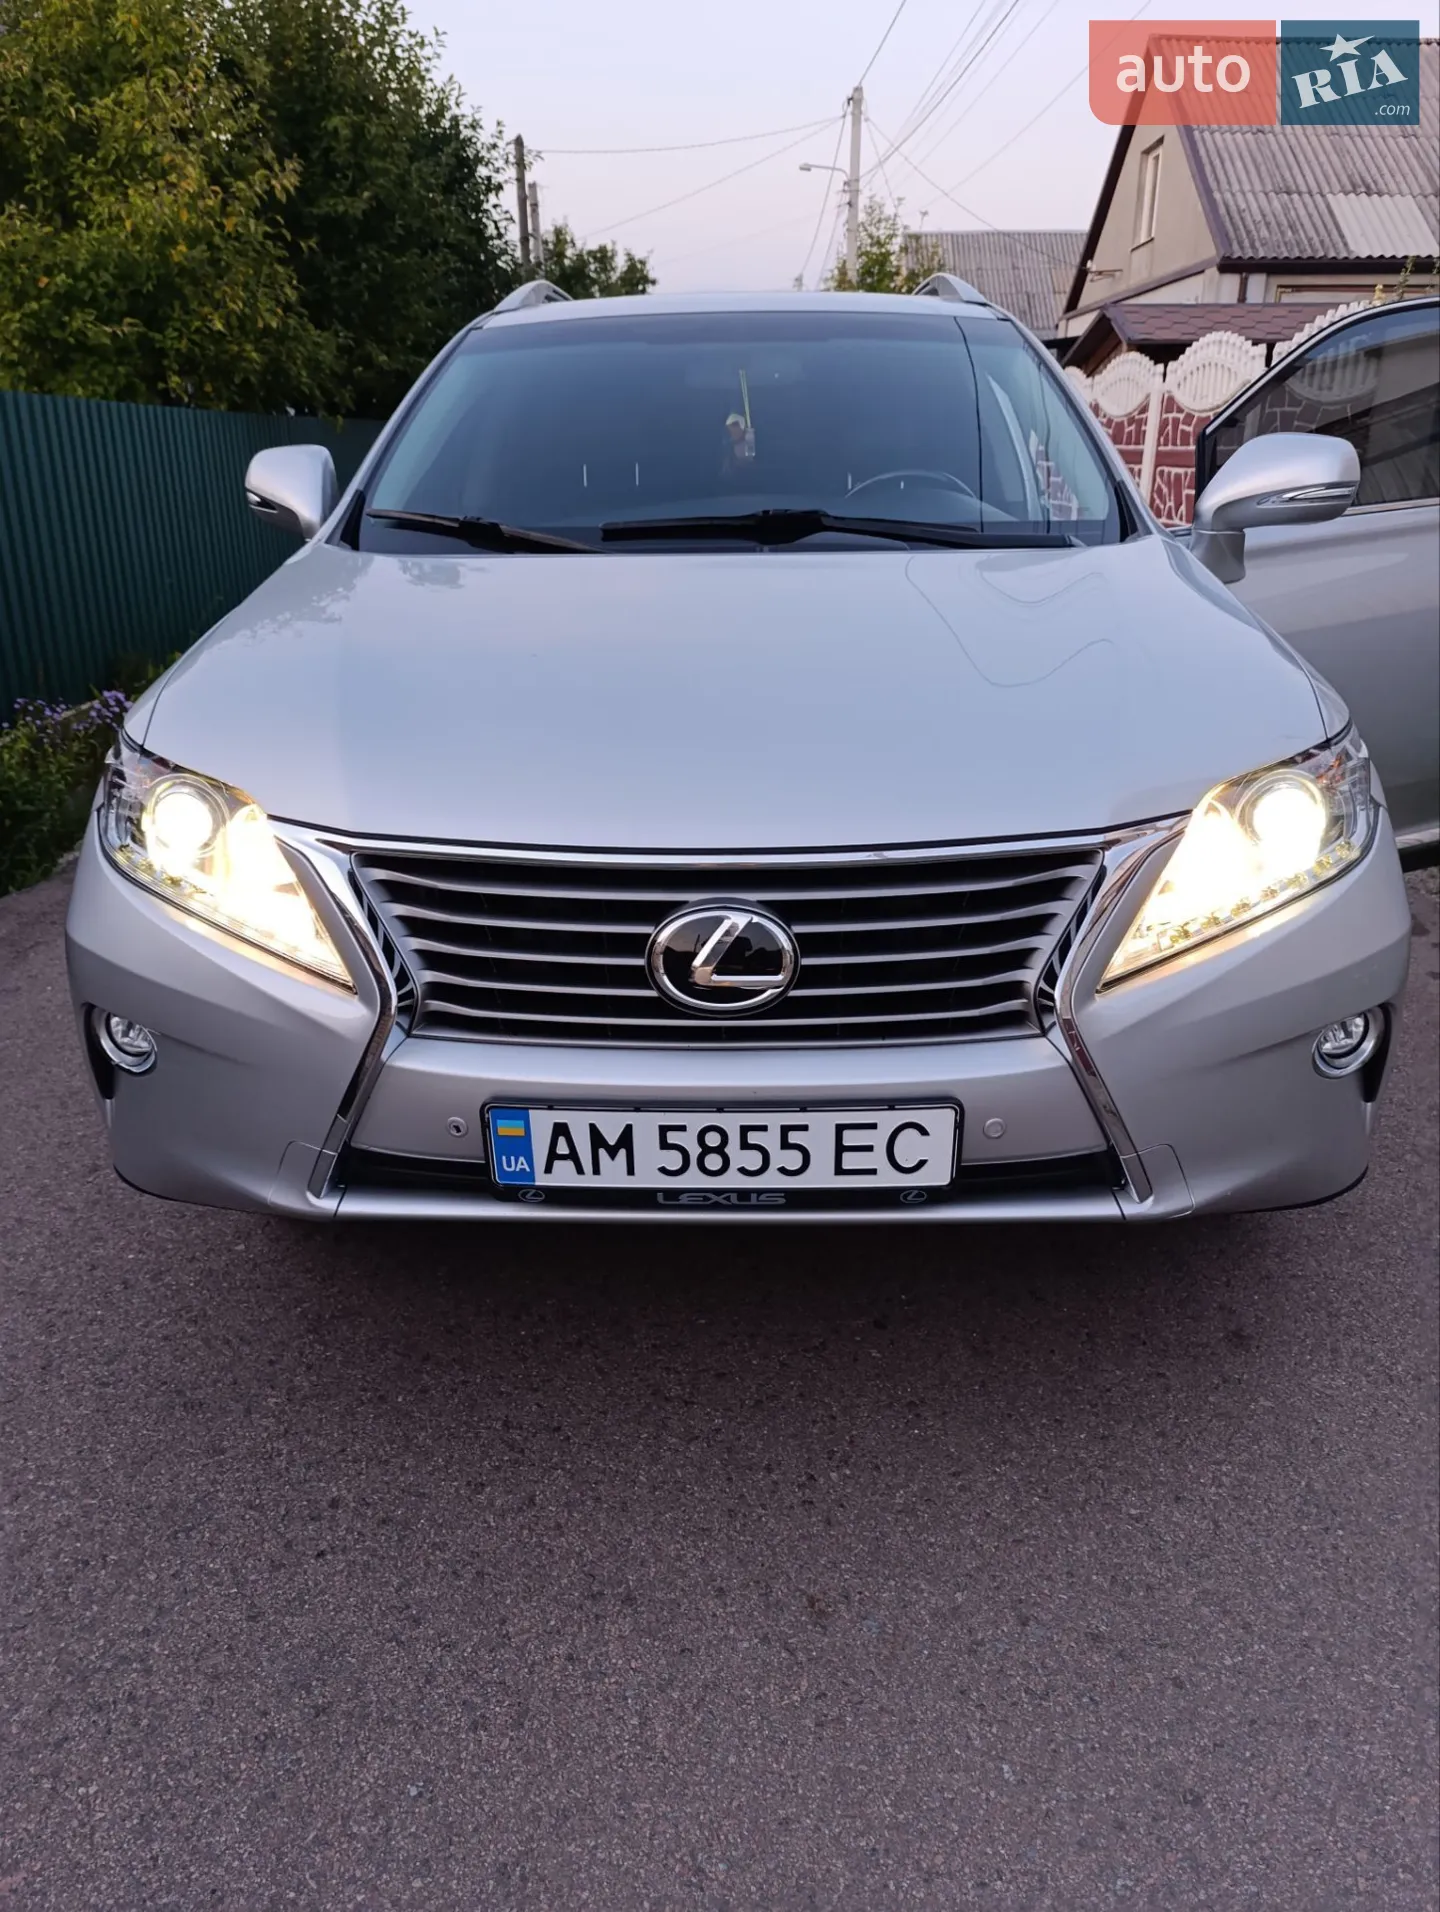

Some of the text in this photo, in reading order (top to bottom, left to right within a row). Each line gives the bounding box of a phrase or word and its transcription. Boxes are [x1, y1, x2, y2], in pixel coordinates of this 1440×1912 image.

[543, 1120, 931, 1178] AM 5855 EC
[502, 1155, 531, 1172] UA
[656, 1191, 787, 1205] LEXUS
